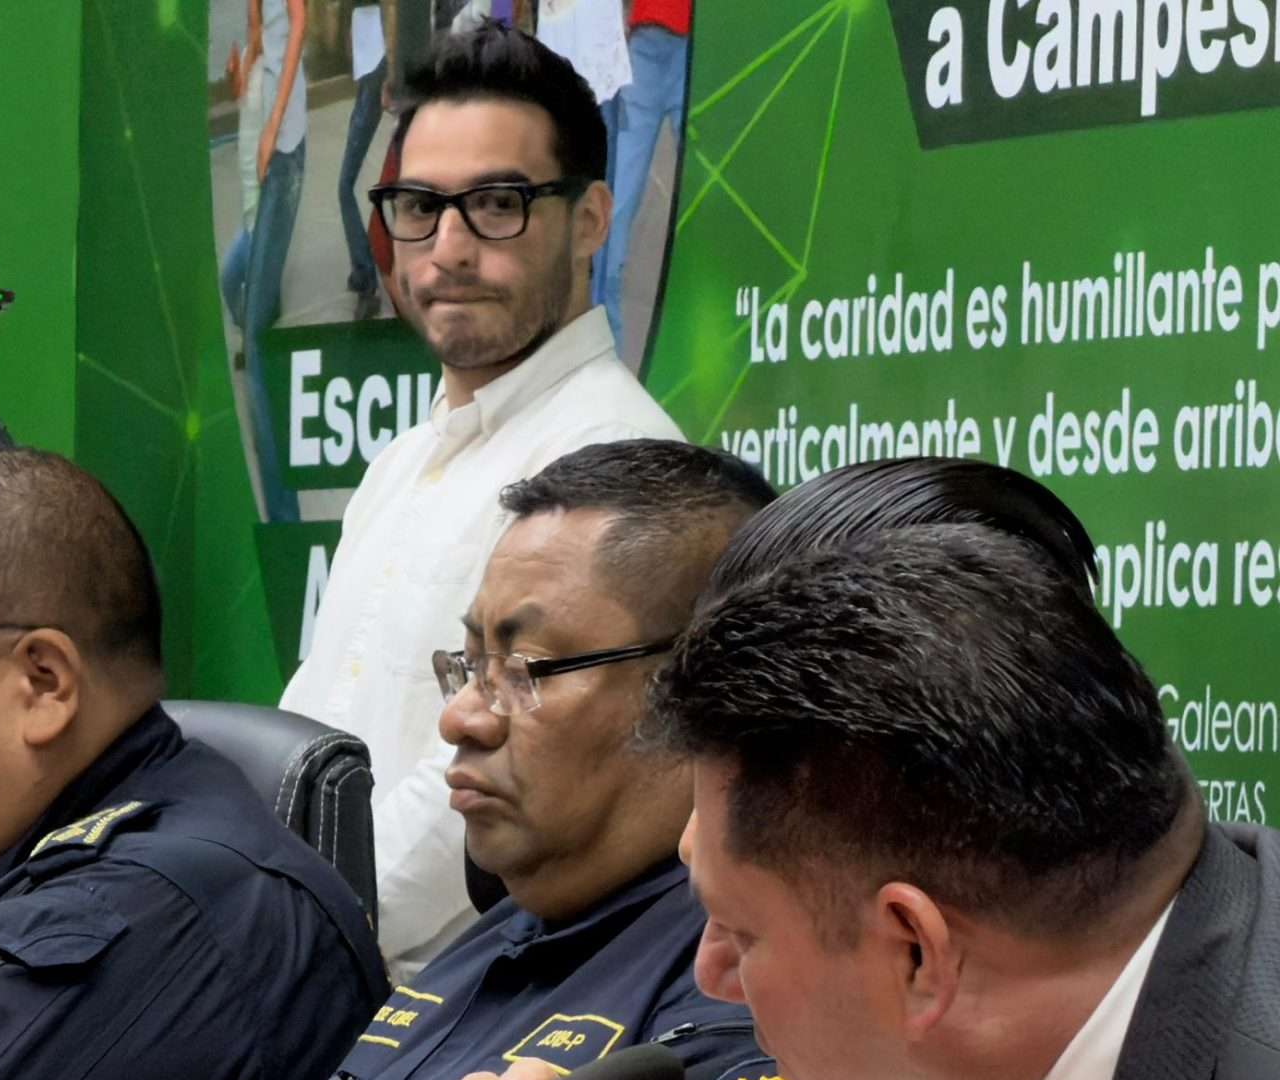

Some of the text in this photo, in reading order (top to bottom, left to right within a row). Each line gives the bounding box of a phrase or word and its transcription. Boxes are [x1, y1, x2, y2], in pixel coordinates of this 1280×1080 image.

[925, 6, 964, 109] a
[800, 267, 954, 360] caridad
[966, 283, 1008, 350] es
[1021, 246, 1243, 345] humillante
[1028, 388, 1160, 476] desde
[1174, 379, 1280, 470] arrib
